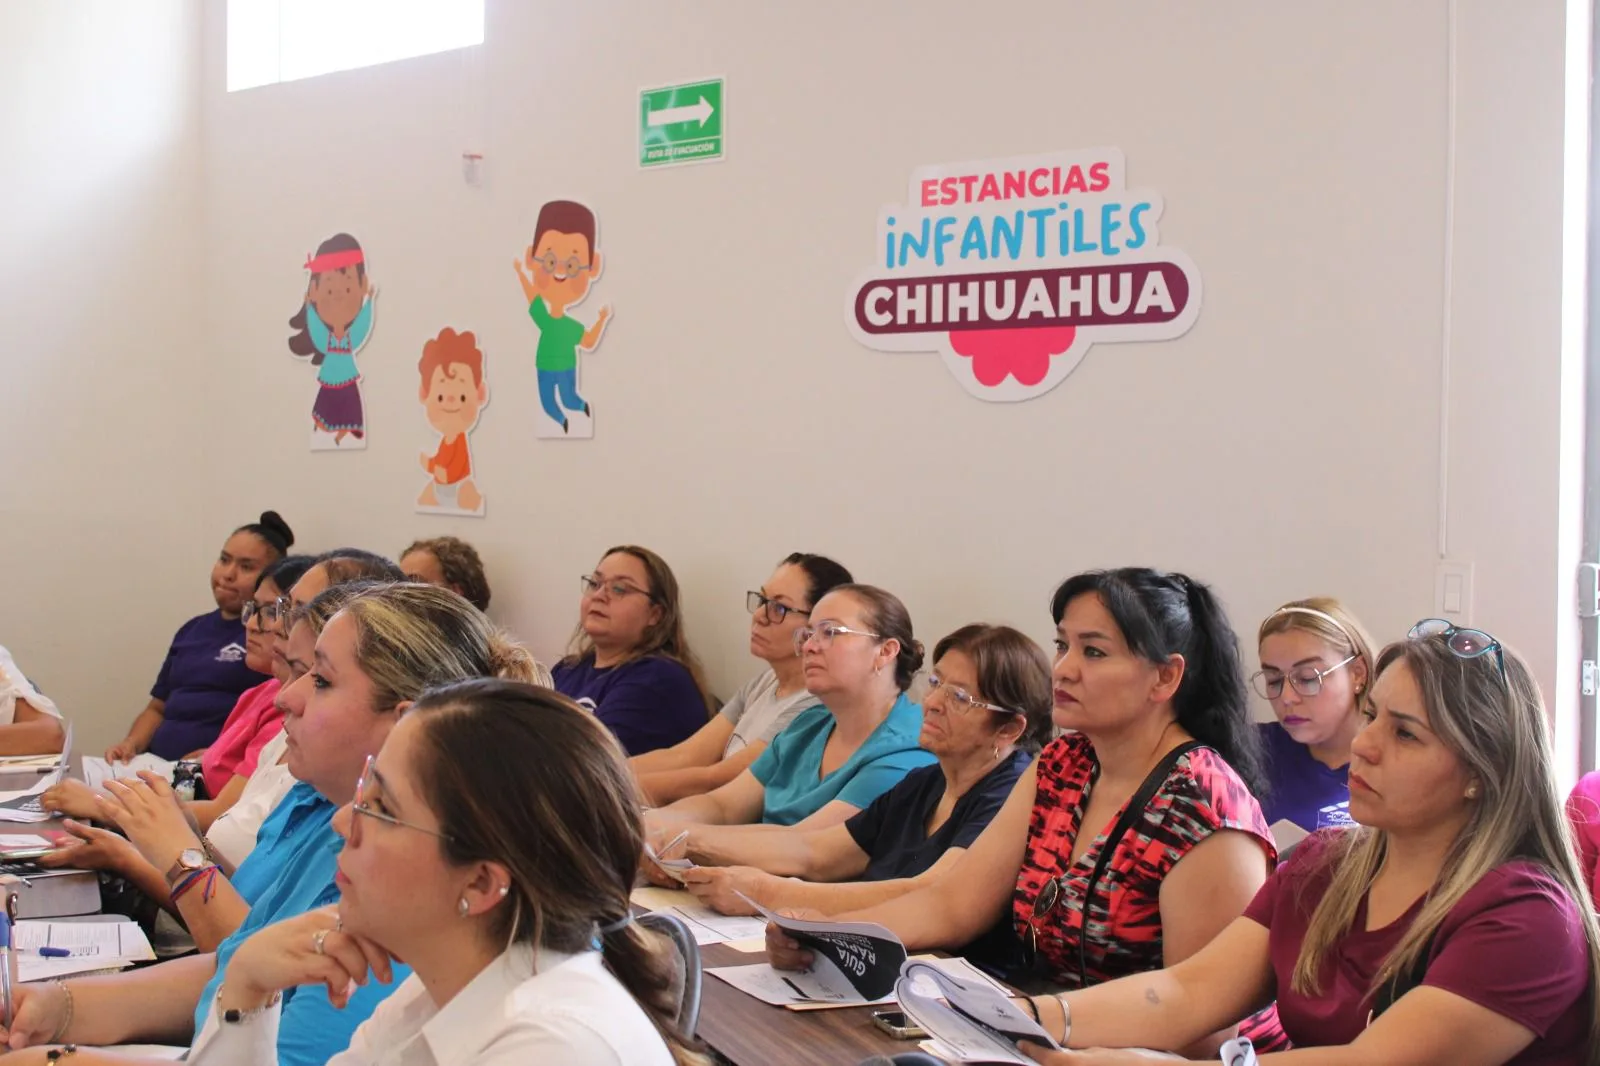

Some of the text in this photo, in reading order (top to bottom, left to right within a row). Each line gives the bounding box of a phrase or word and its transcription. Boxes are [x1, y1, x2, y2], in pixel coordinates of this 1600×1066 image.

[921, 162, 1110, 207] ESTANCIAS
[864, 270, 1176, 326] CHIHUAHUA
[836, 946, 866, 977] GUÍA
